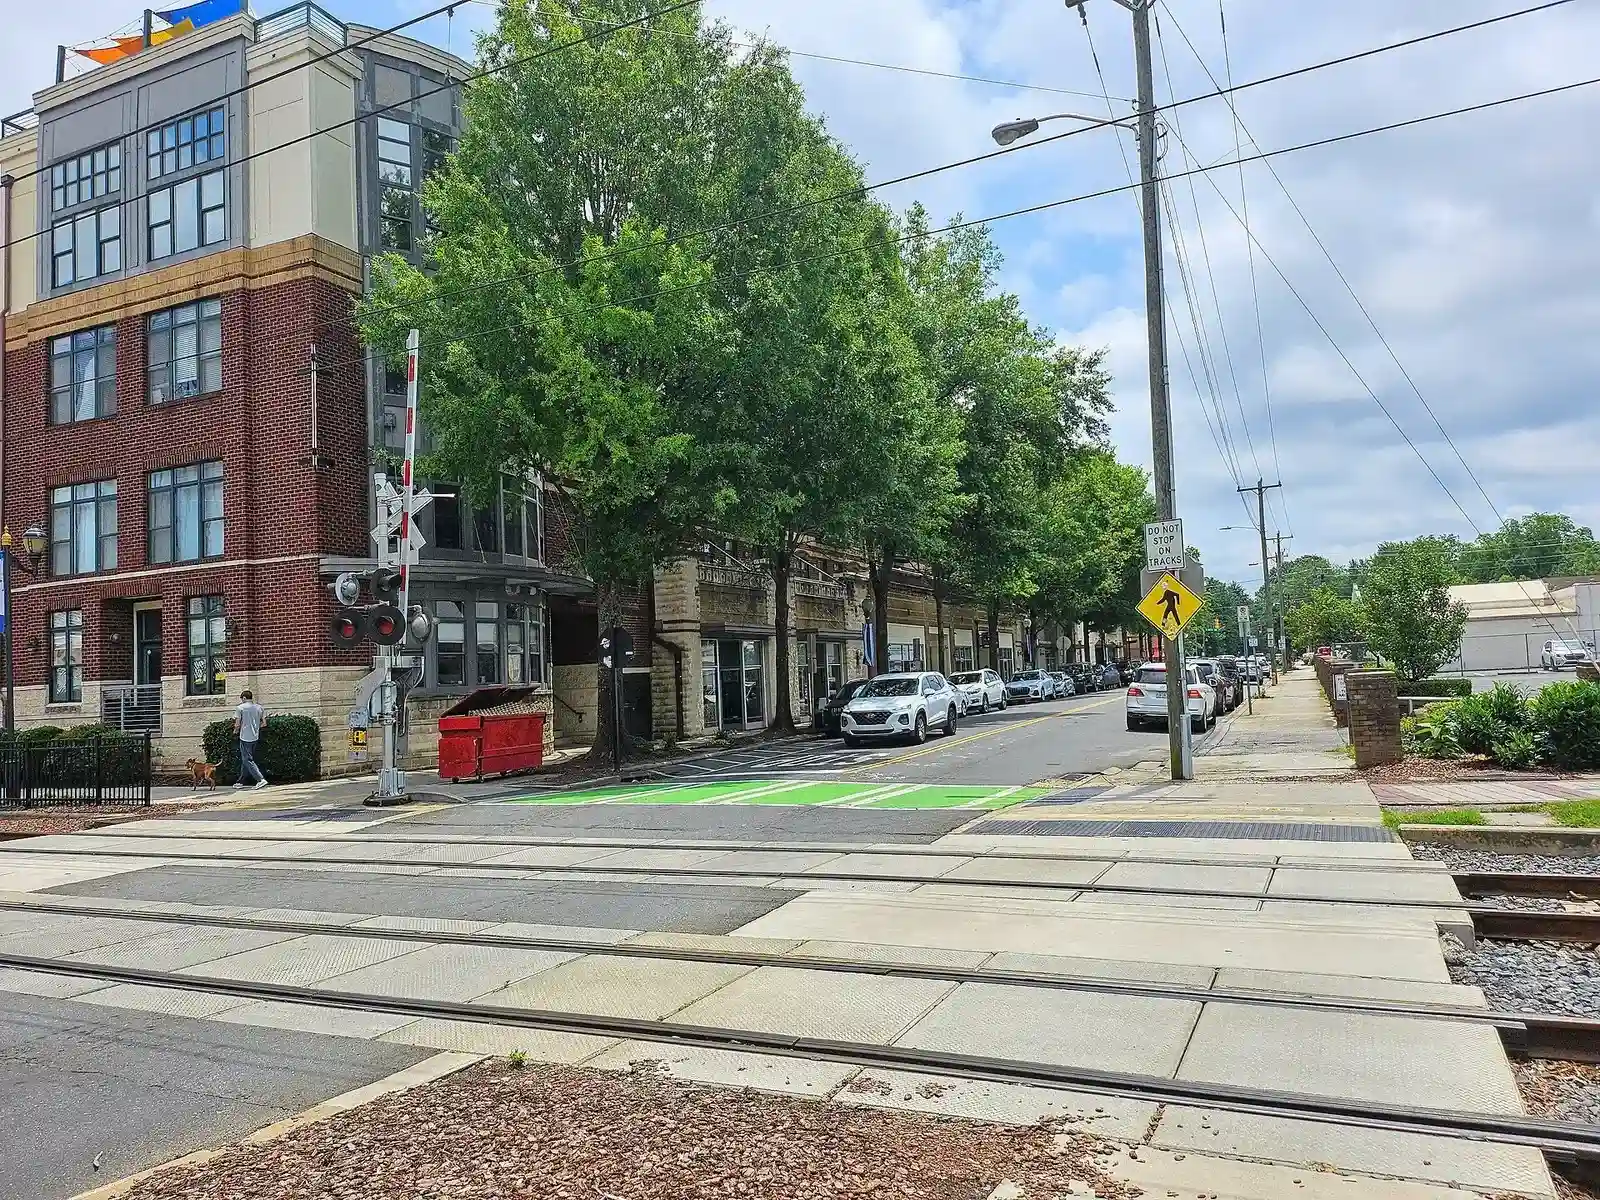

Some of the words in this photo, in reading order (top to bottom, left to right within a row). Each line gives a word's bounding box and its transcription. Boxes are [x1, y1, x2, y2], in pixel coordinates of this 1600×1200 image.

[1148, 527, 1159, 535] DO
[1163, 524, 1179, 533] NOT
[1153, 536, 1174, 545] STOP
[1159, 547, 1170, 555] ON
[1149, 556, 1181, 566] TRACKS
